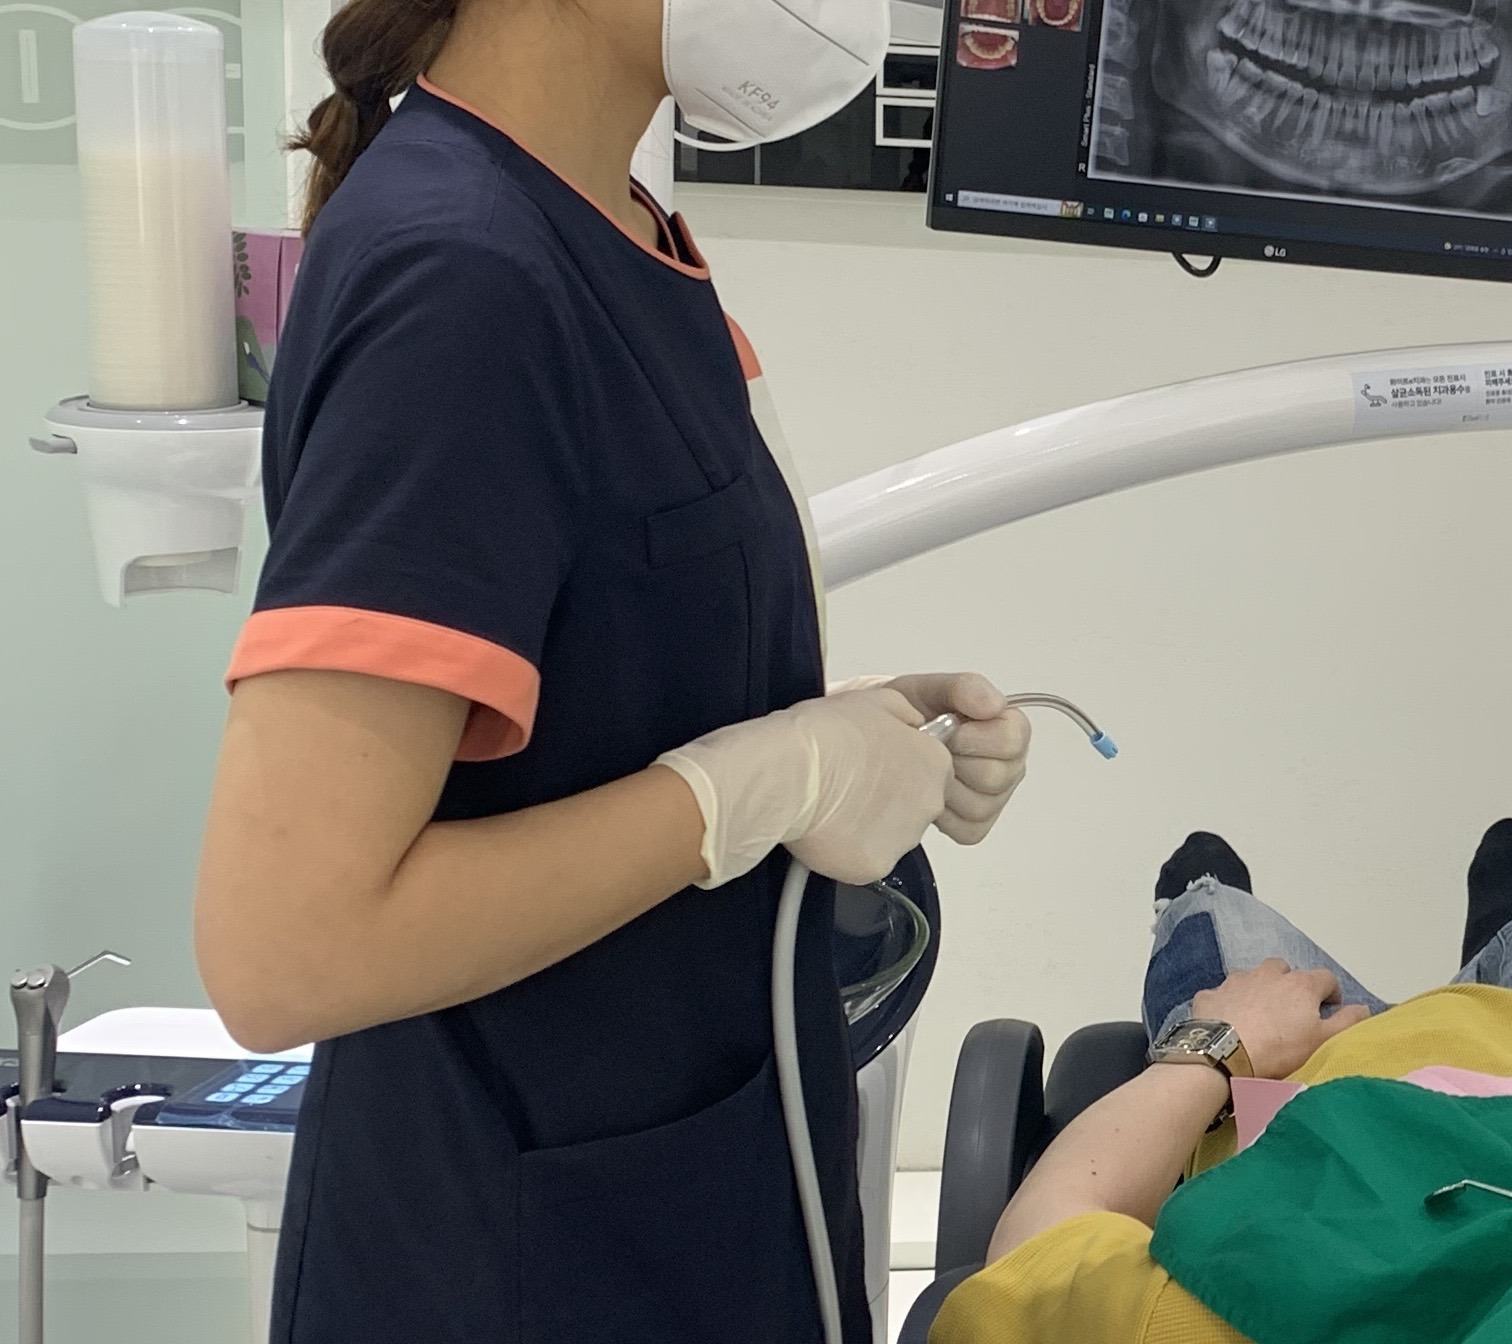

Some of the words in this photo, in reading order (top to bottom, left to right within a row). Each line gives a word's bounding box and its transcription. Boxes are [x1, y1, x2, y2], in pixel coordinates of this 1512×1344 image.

[738, 81, 780, 110] KF94
[1078, 162, 1086, 173] R
[1391, 386, 1432, 398] 살균소독된
